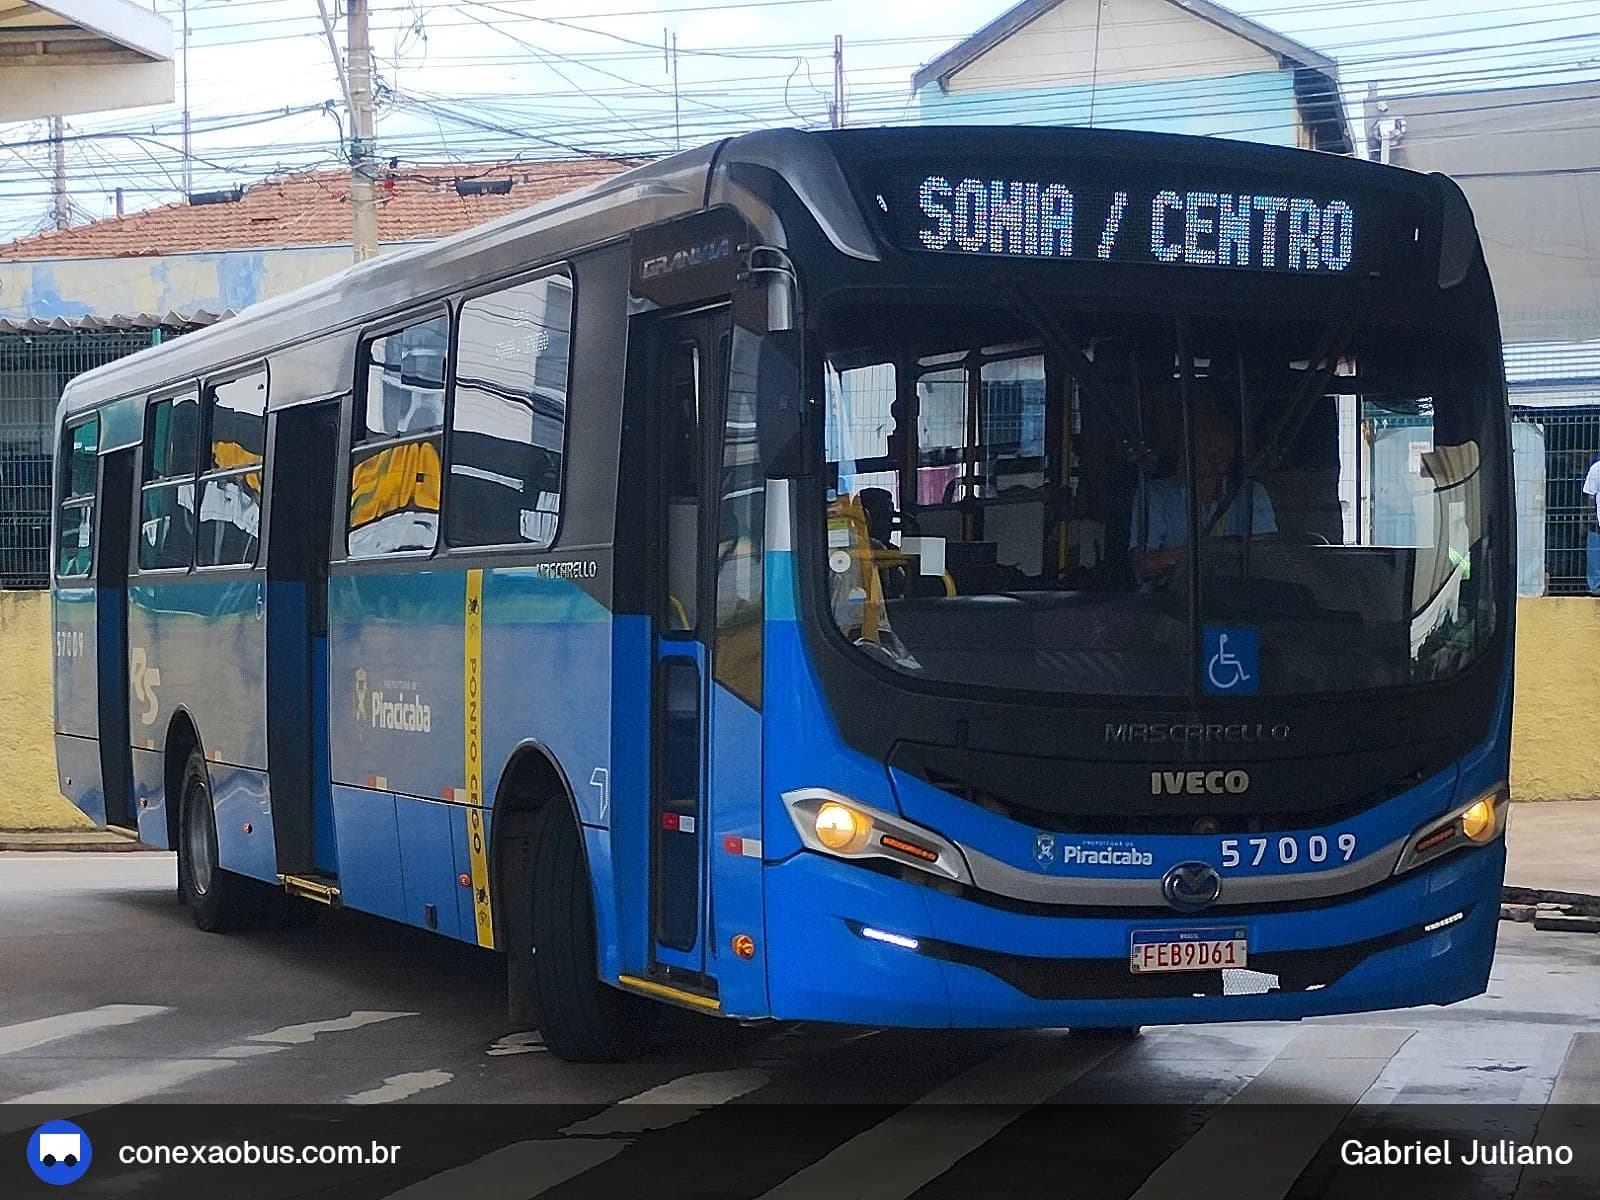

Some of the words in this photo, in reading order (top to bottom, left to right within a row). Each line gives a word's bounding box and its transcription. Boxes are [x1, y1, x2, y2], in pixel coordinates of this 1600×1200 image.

[1151, 190, 1354, 272] CENTRO
[372, 691, 432, 733] Piracicaba
[468, 658, 478, 762] PONTO
[1105, 723, 1291, 743] MASCARELLO
[1151, 771, 1249, 795] IVECO
[1064, 845, 1153, 866] Piracicaba
[1221, 834, 1357, 867] 57009
[1143, 942, 1235, 967] FEB9D61
